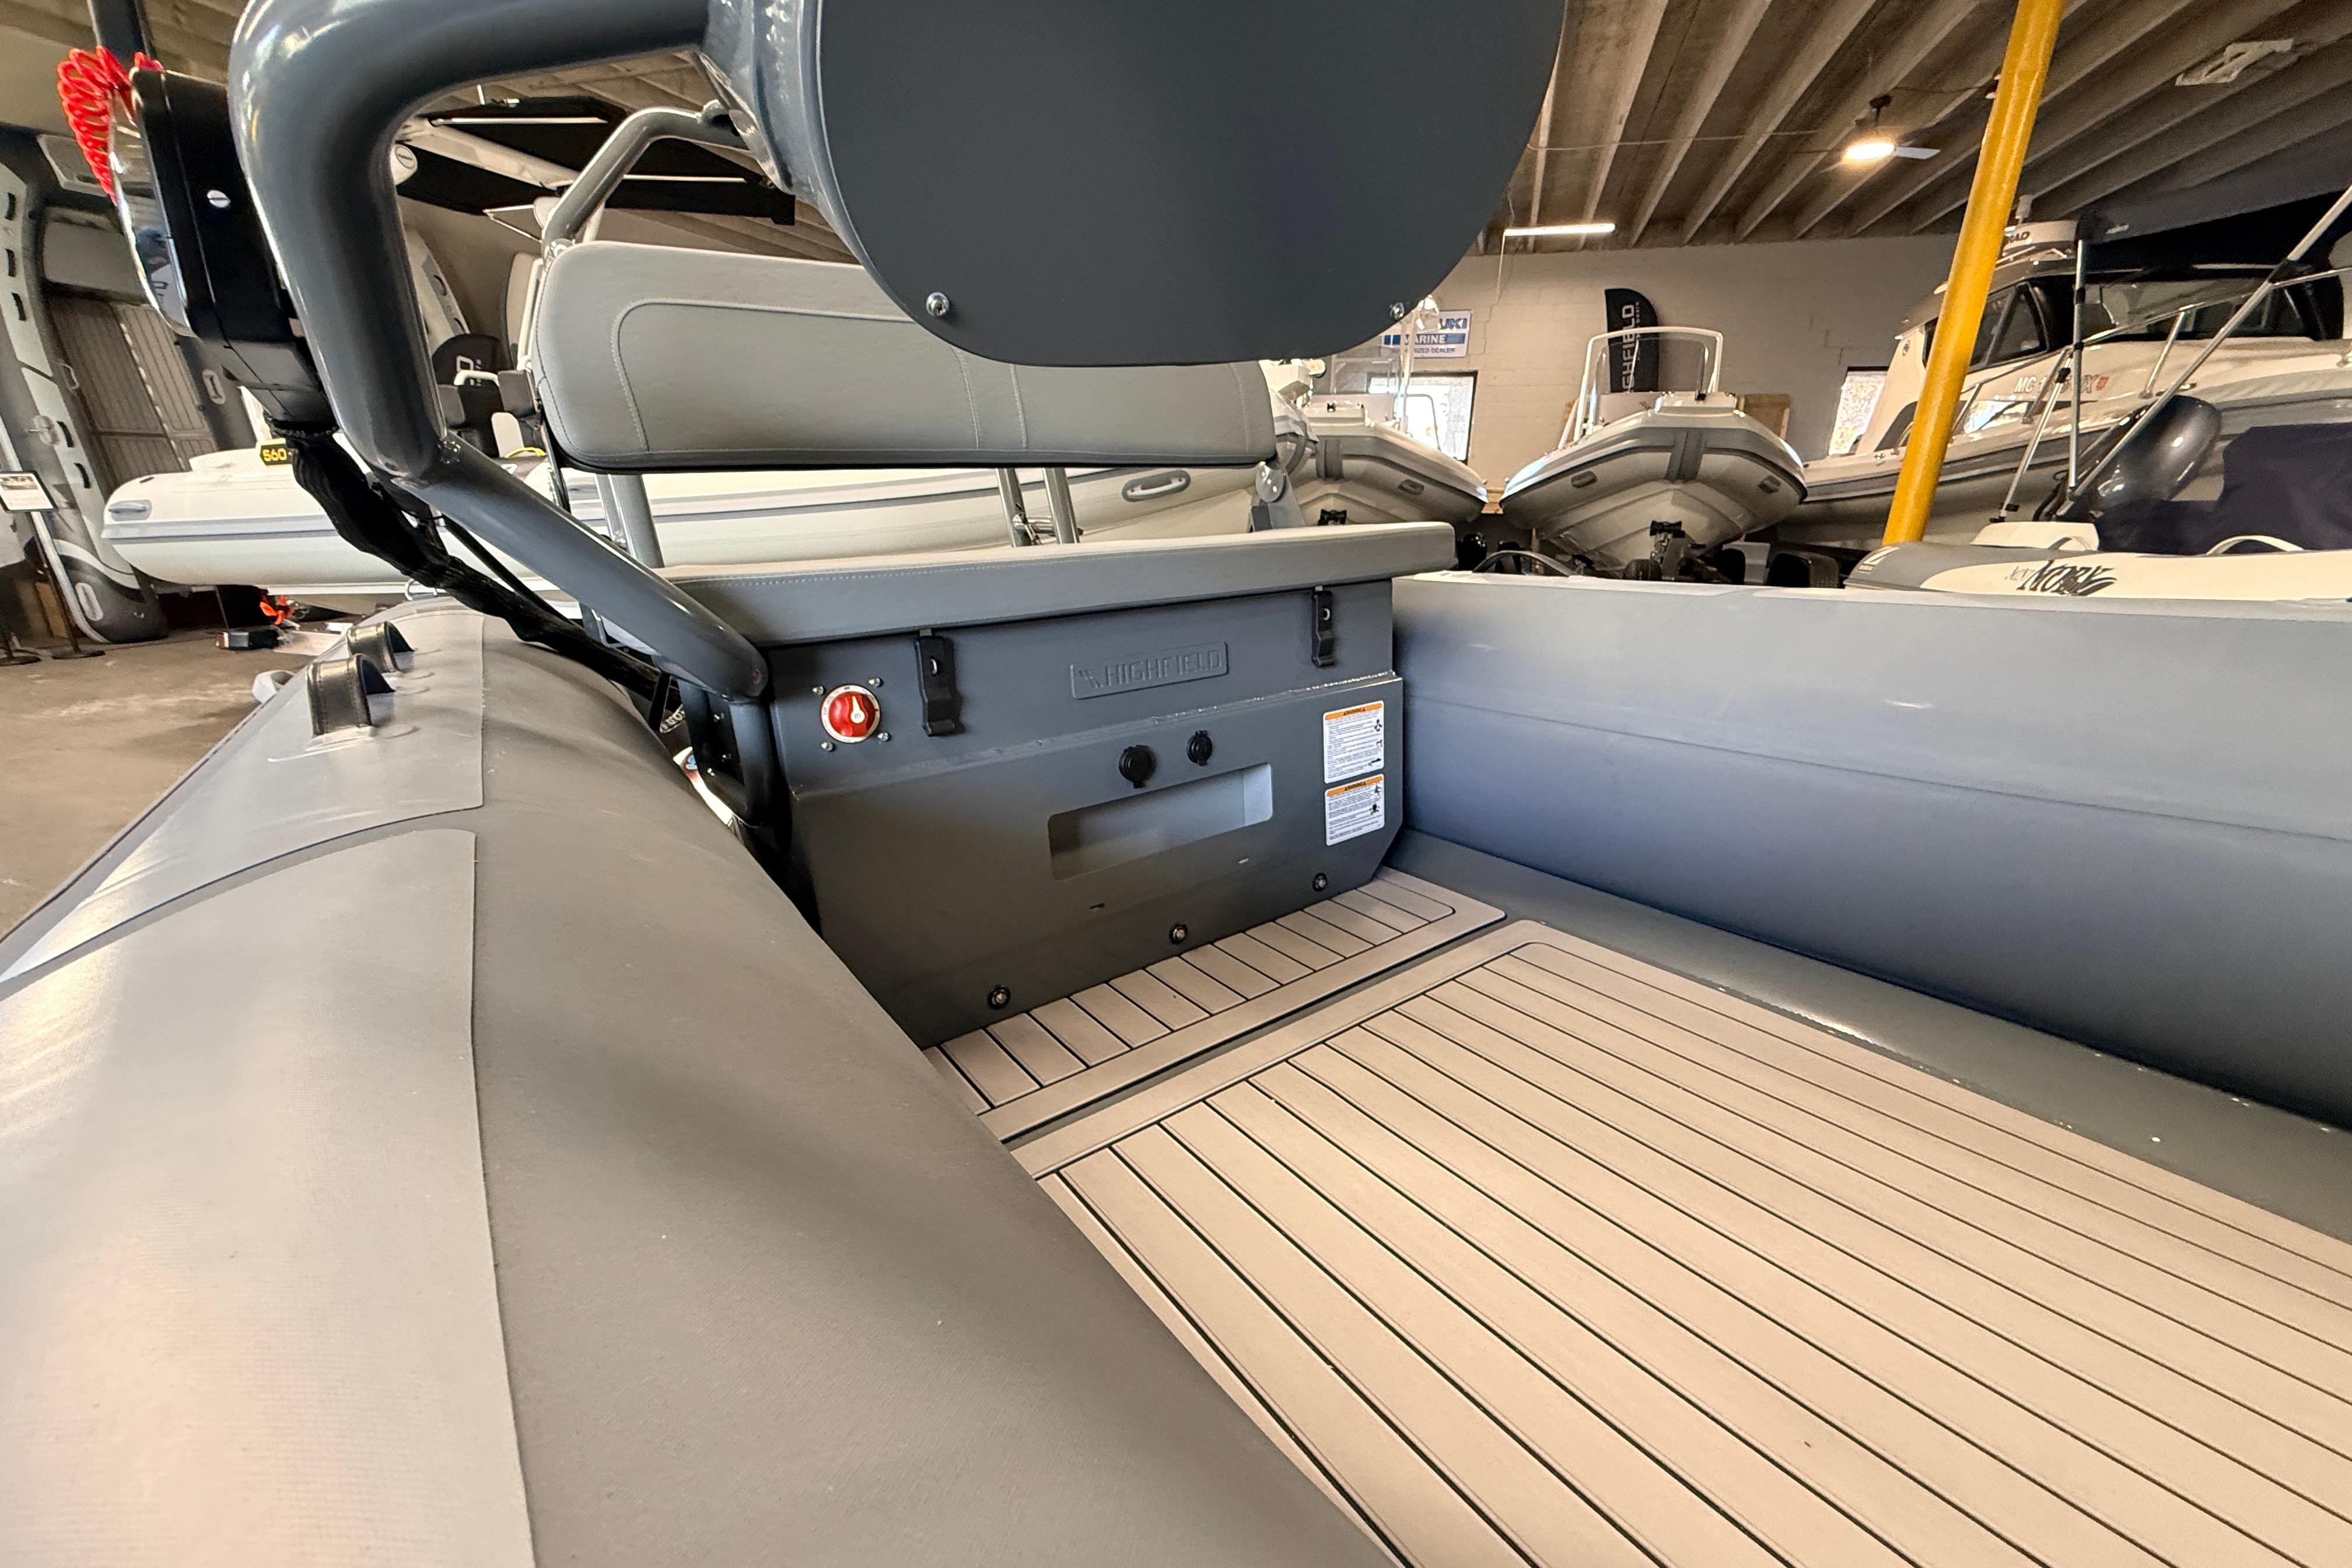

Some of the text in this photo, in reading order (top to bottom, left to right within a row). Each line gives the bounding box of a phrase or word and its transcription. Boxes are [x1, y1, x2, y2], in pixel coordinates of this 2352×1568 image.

[1622, 304, 1636, 390] GHFIELD
[2014, 376, 2036, 393] MC
[1105, 649, 1223, 687] HIGHFIELD
